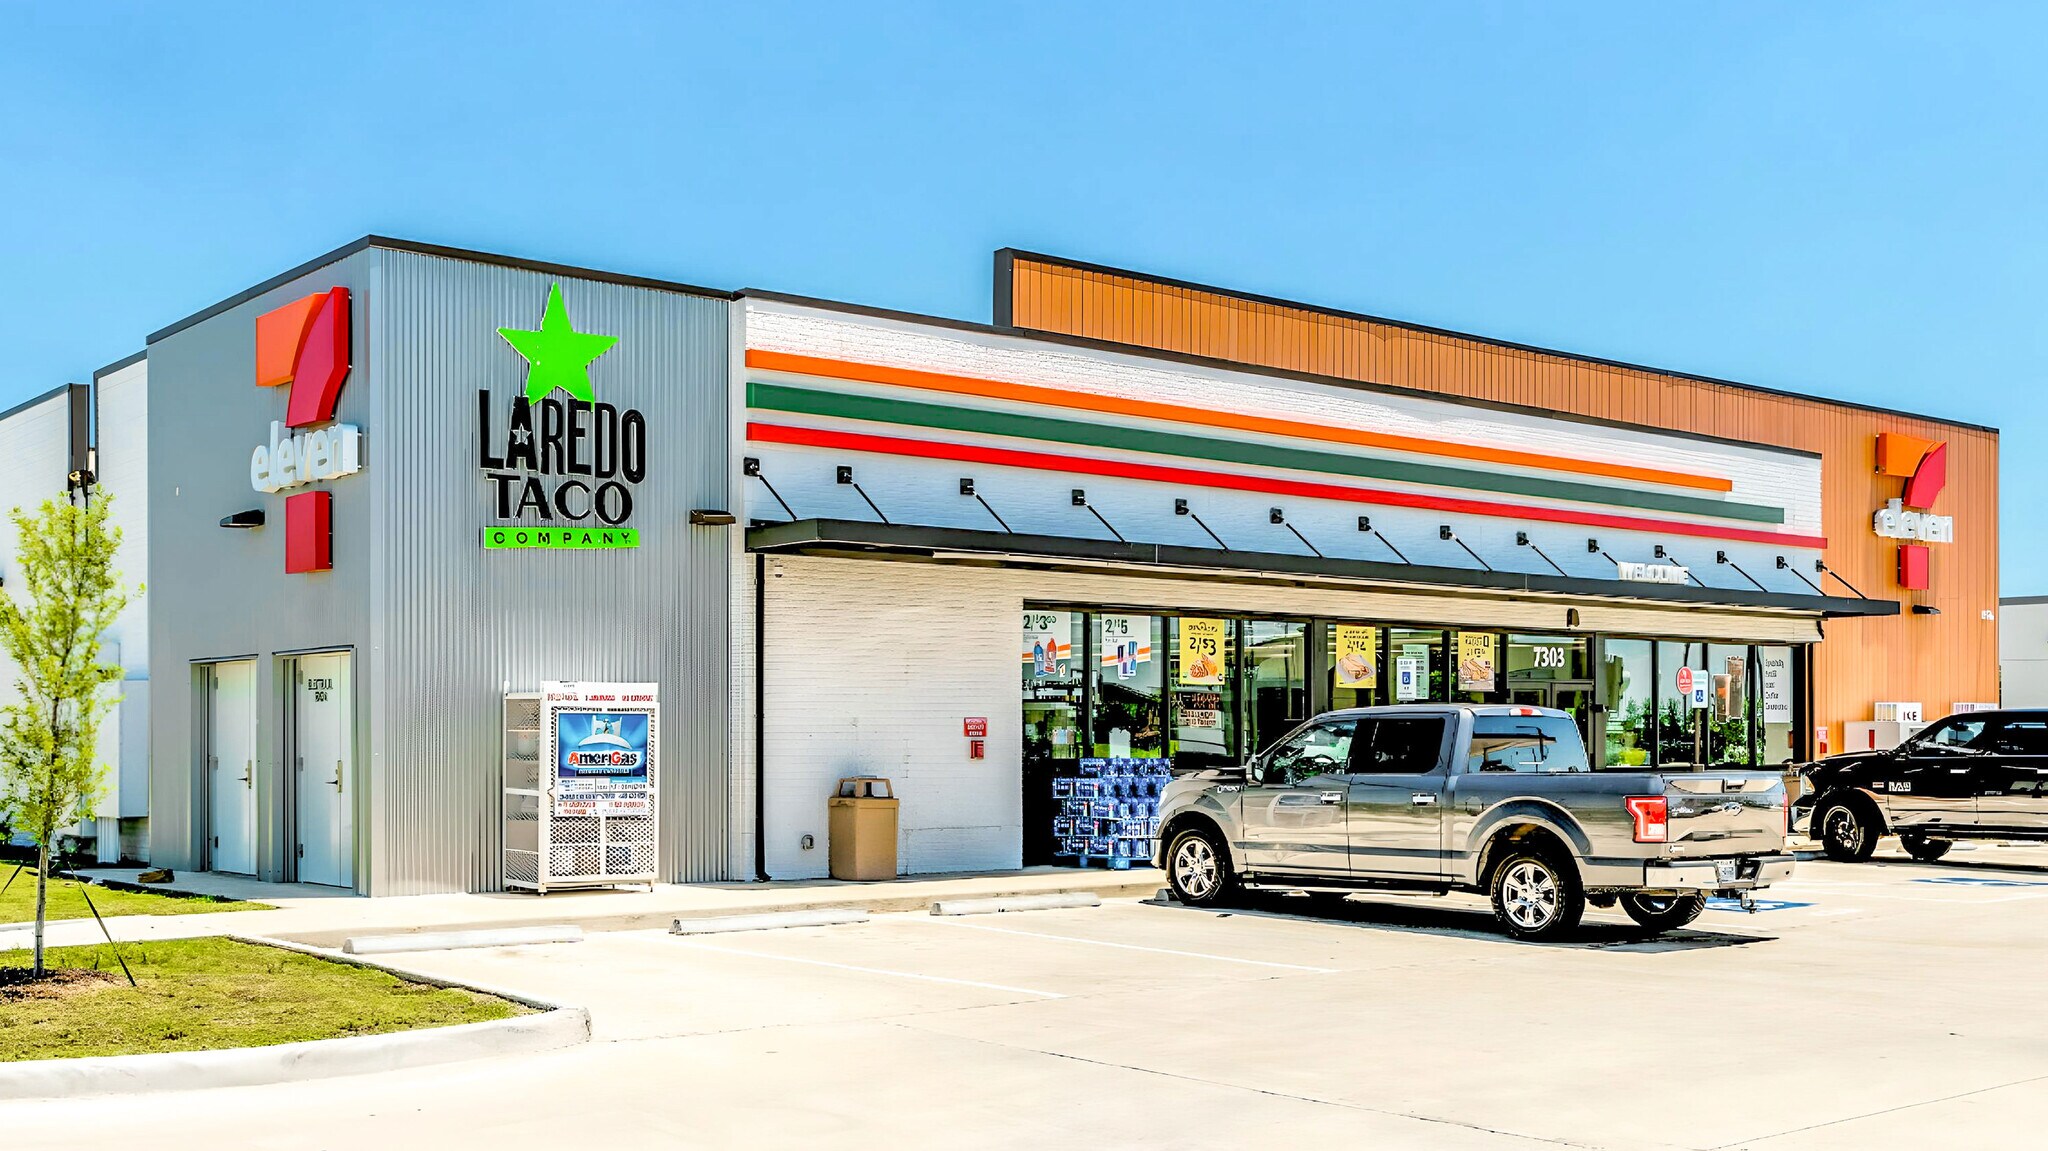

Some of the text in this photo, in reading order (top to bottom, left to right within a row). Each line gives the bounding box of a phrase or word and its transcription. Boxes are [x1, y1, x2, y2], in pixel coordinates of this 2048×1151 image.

[478, 388, 646, 484] LAREDO
[250, 420, 361, 492] eleven
[486, 473, 633, 525] TACO
[493, 530, 632, 544] COMPANY
[1533, 646, 1566, 668] 7303
[568, 751, 638, 766] AmeriGas
